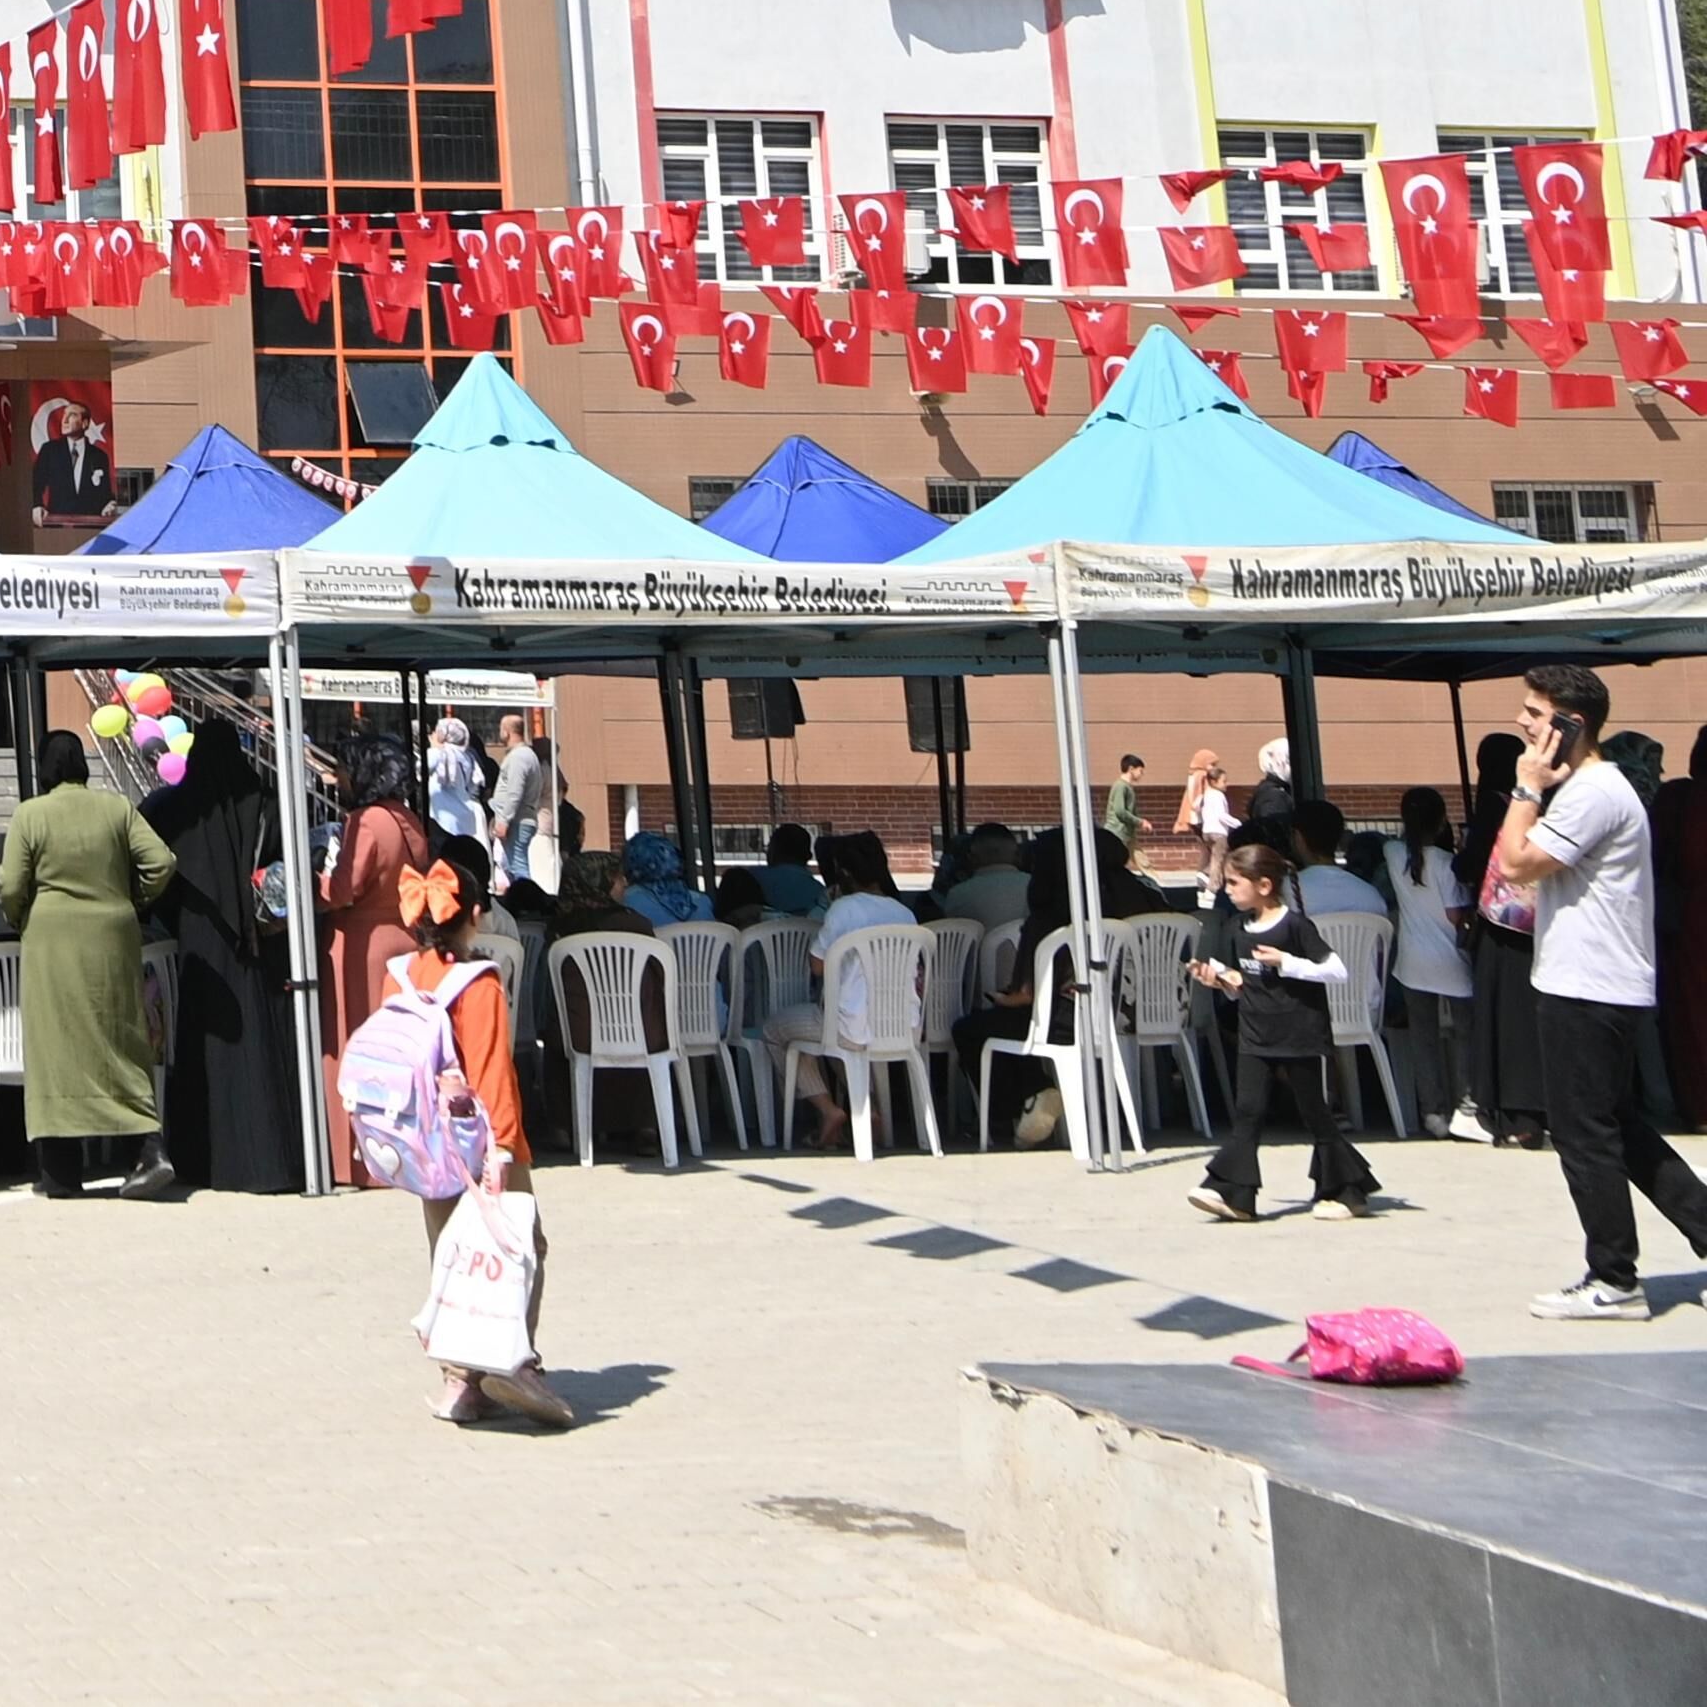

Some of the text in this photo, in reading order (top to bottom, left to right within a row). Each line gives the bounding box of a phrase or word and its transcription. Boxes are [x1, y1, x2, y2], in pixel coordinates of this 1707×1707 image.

[120, 585, 219, 598] Kahramanmaraş
[454, 568, 891, 617] Kahramanmaraş Büyükşehir Belediyesi
[1078, 567, 1184, 586] Kahramanmaraş
[1229, 556, 1635, 607] Kahramanmaraş Büyükşehir Belediyesi
